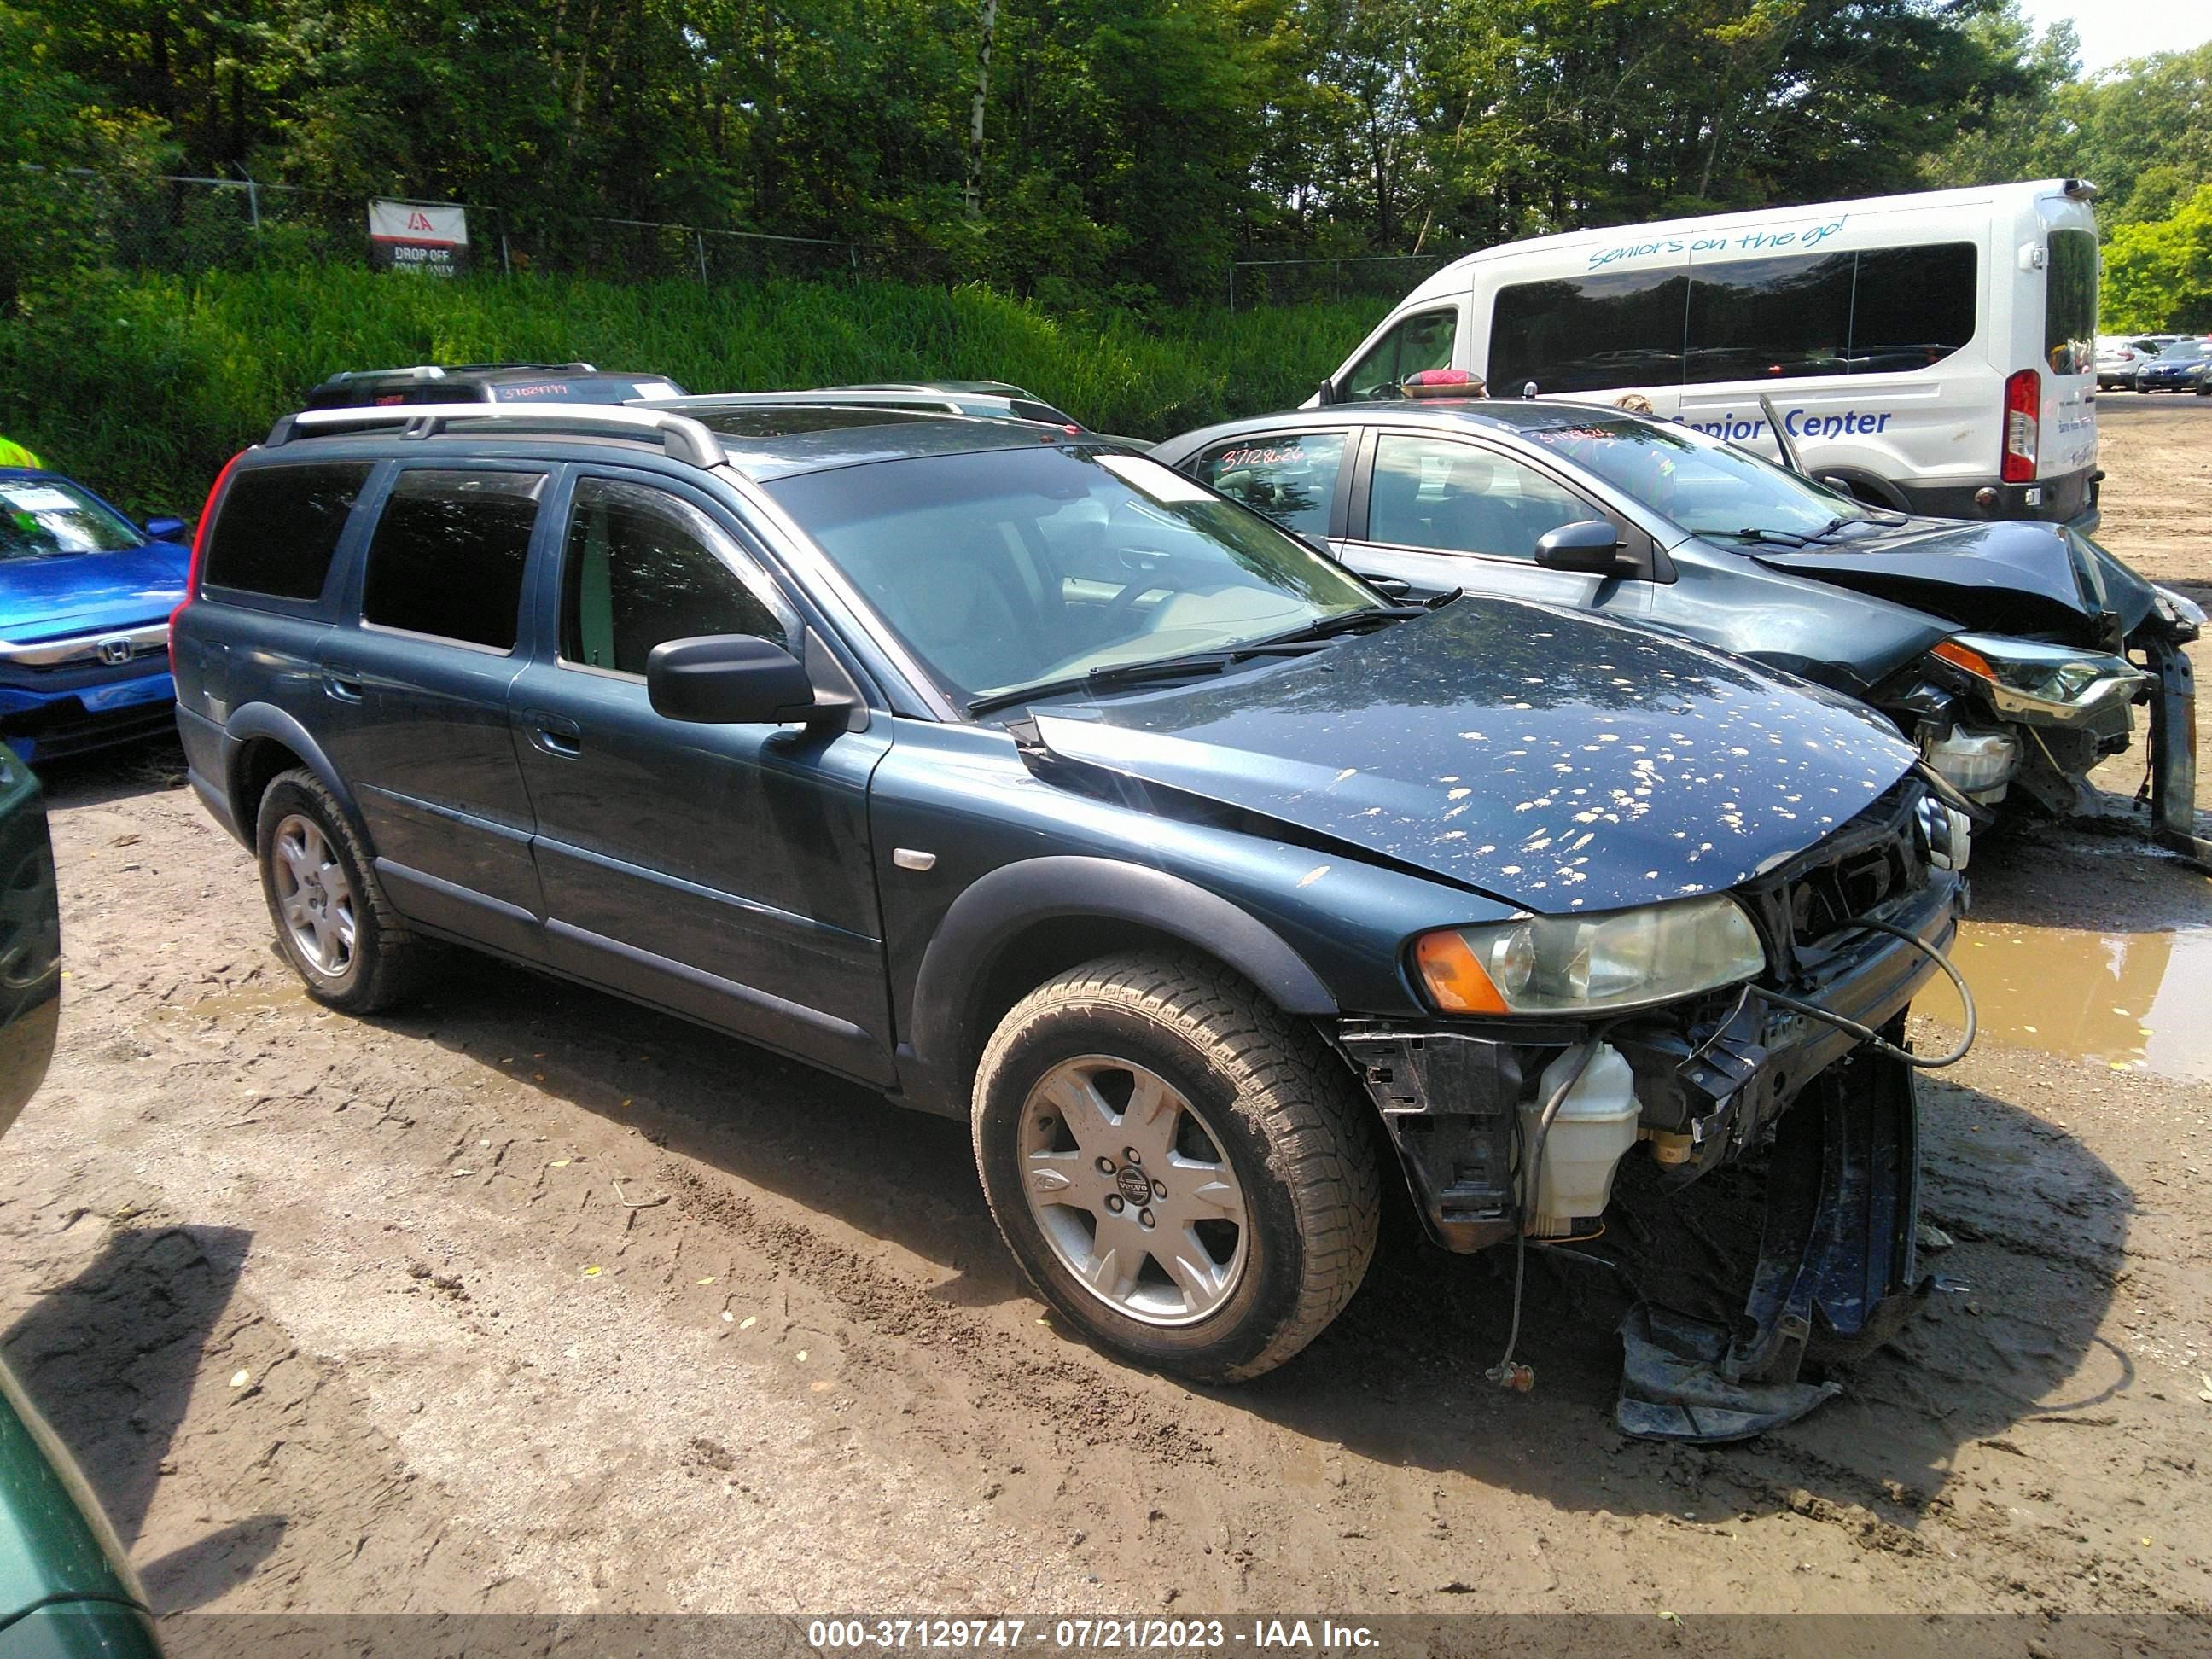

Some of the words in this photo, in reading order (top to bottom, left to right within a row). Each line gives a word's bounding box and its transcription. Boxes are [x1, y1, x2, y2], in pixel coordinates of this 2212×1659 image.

[1691, 237, 1725, 252] on
[1735, 231, 1796, 249] the
[1802, 213, 1849, 248] go!
[395, 247, 427, 261] DROP
[429, 249, 449, 262] OFF
[1784, 409, 1892, 439] Center
